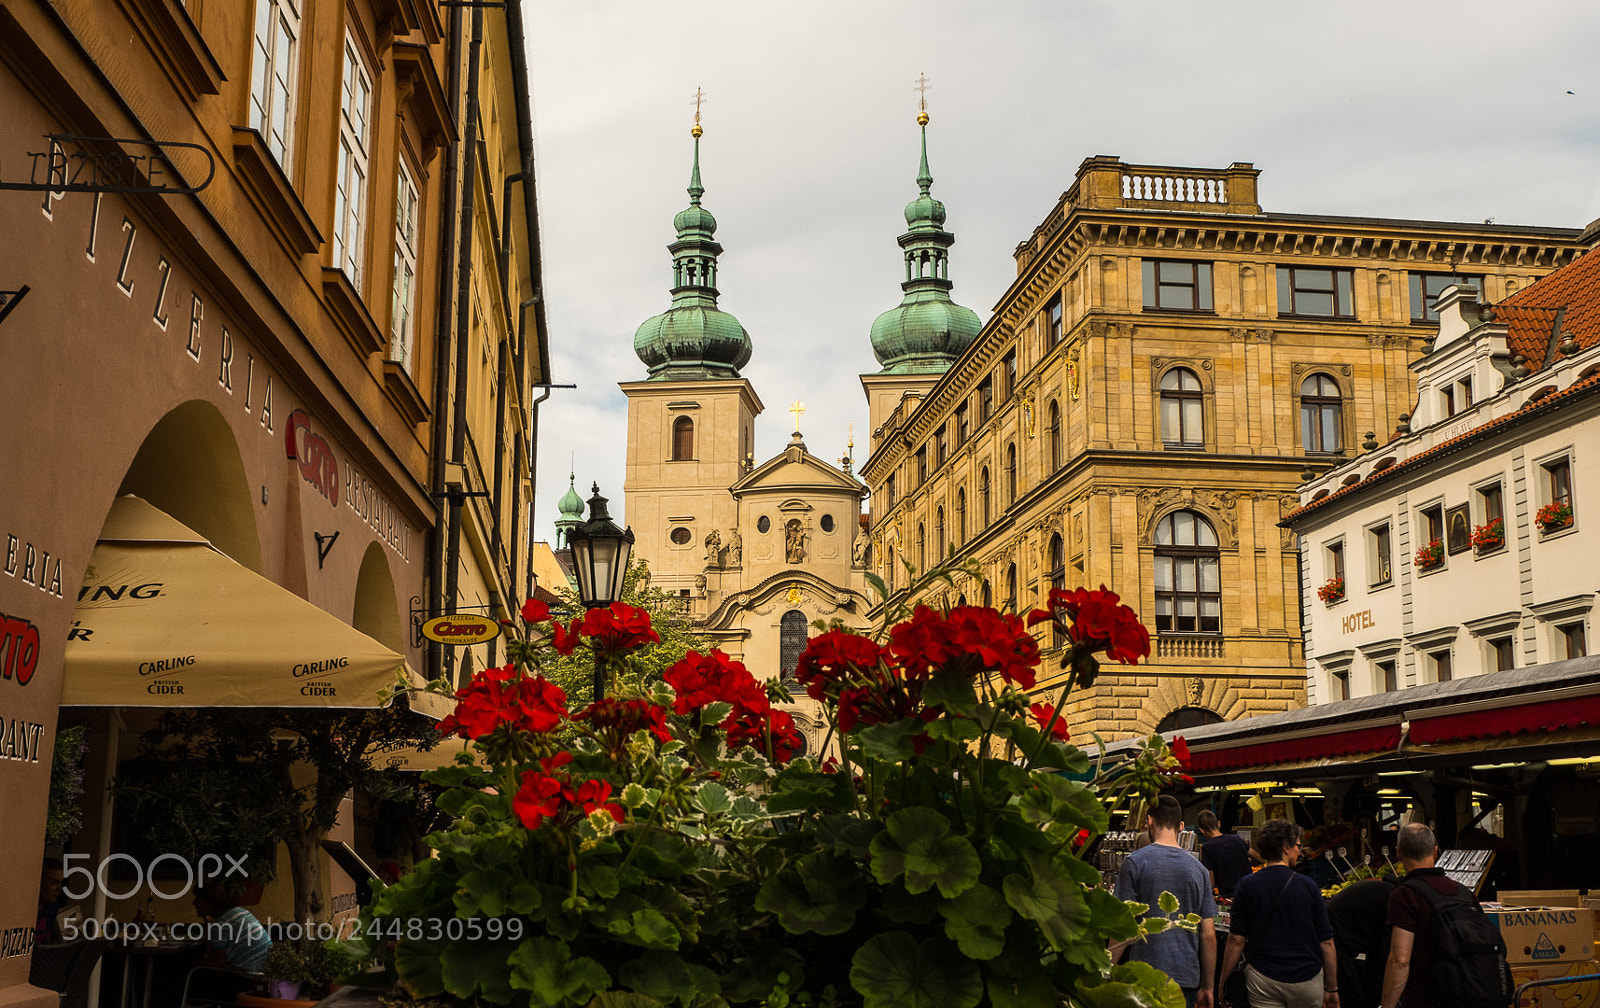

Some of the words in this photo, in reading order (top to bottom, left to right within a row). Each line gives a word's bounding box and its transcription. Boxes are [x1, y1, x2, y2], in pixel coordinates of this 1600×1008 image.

[41, 134, 275, 437] PIZZERIA
[344, 458, 412, 564] RESTAURANT
[3, 532, 64, 600] ERIA
[1342, 609, 1376, 635] HOTEL
[138, 655, 195, 677] CARLING
[292, 656, 348, 678] CARLING
[147, 684, 184, 694] CIDER
[300, 686, 337, 697] CIDER
[1504, 910, 1577, 927] BANANAS
